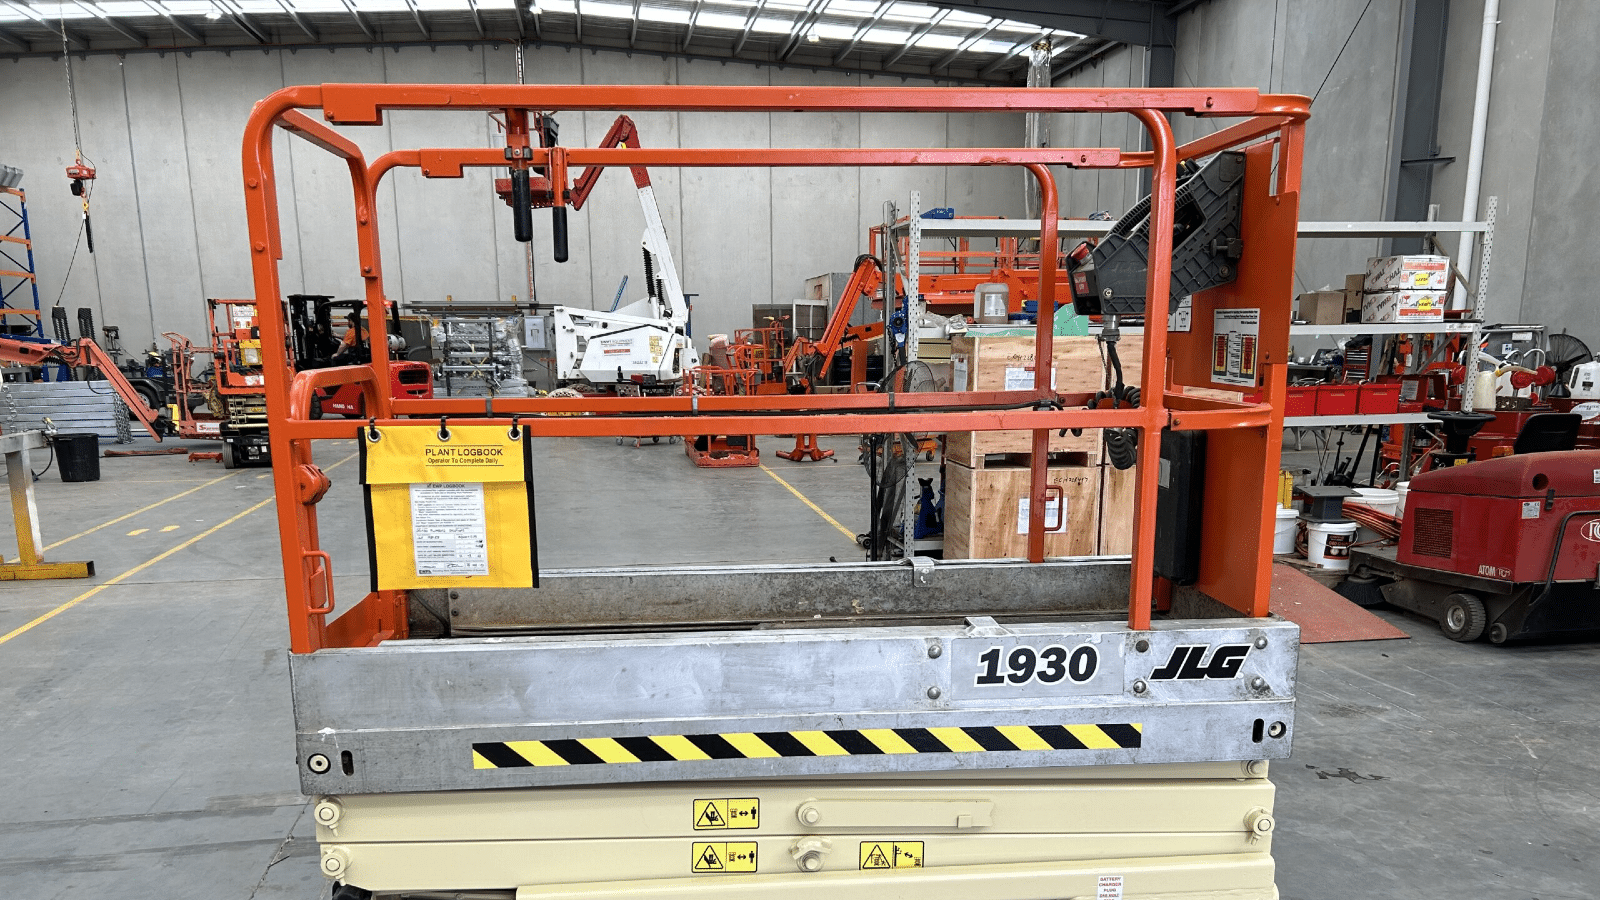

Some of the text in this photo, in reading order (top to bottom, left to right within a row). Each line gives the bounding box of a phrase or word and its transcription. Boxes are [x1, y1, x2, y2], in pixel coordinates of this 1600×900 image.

[426, 448, 503, 456] PLANT LOGBOOK
[1478, 564, 1496, 577] ATOM
[975, 645, 1098, 686] 1930
[1150, 645, 1253, 680] JLG
